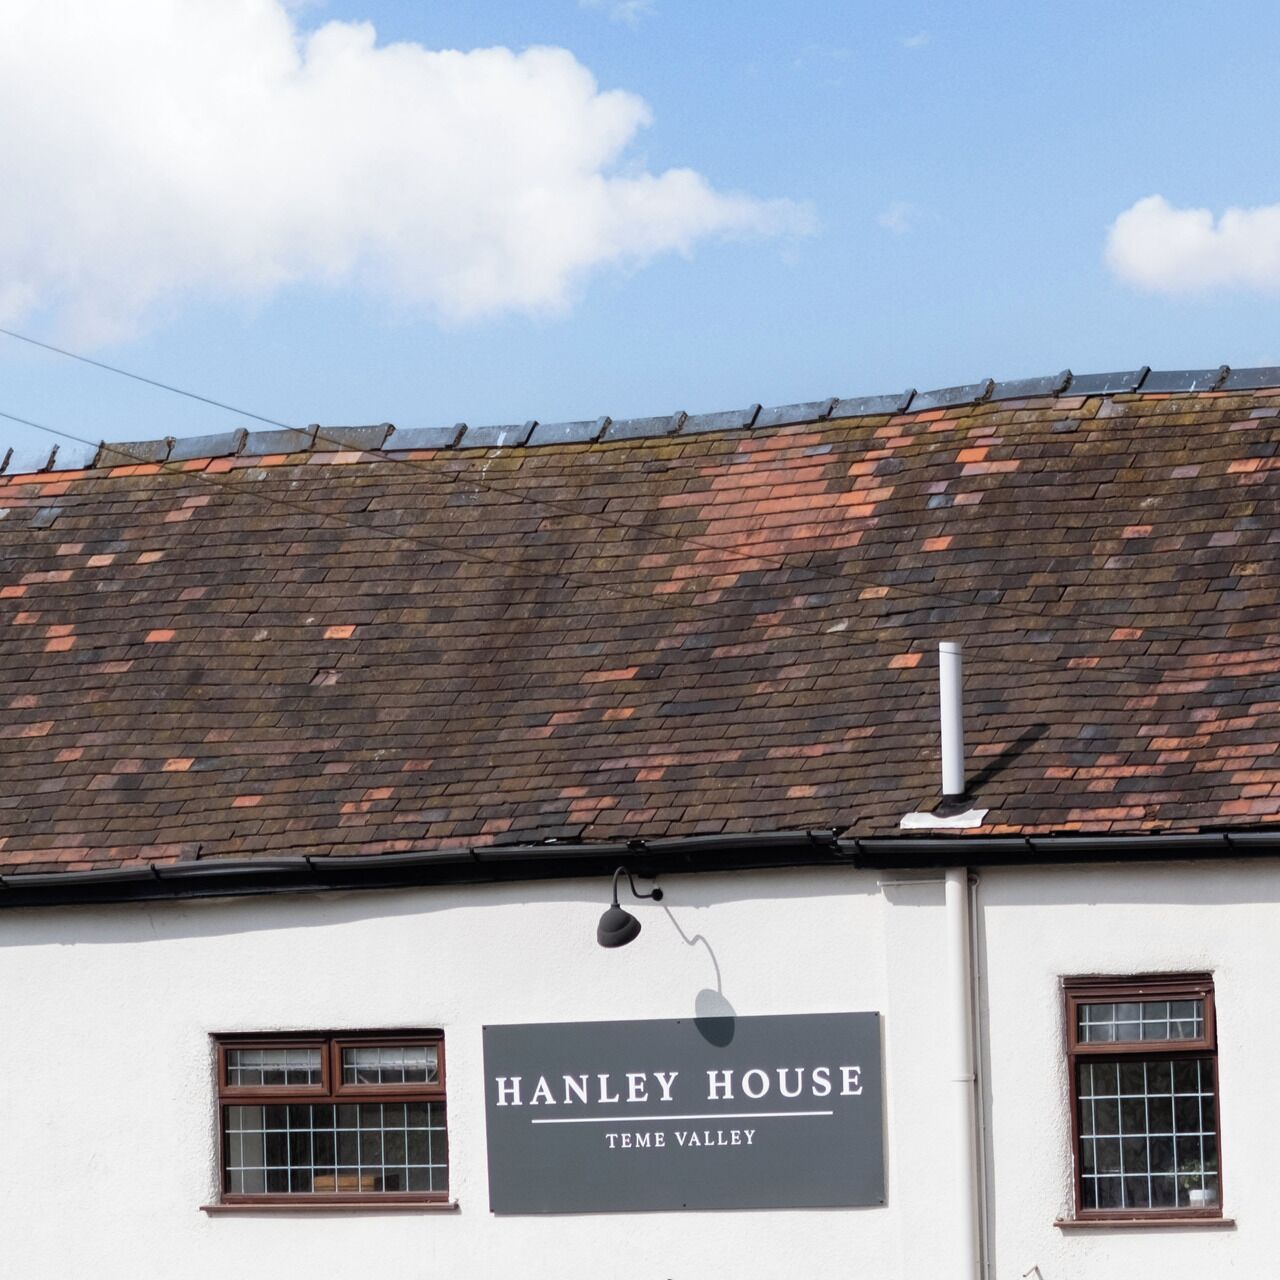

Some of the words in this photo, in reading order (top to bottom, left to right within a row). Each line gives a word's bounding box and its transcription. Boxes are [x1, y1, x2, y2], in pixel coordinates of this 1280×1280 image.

[495, 1071, 679, 1106] HANLEY
[706, 1065, 864, 1100] HOUSE
[605, 1132, 666, 1149] TEME
[674, 1129, 756, 1147] VALLEY
